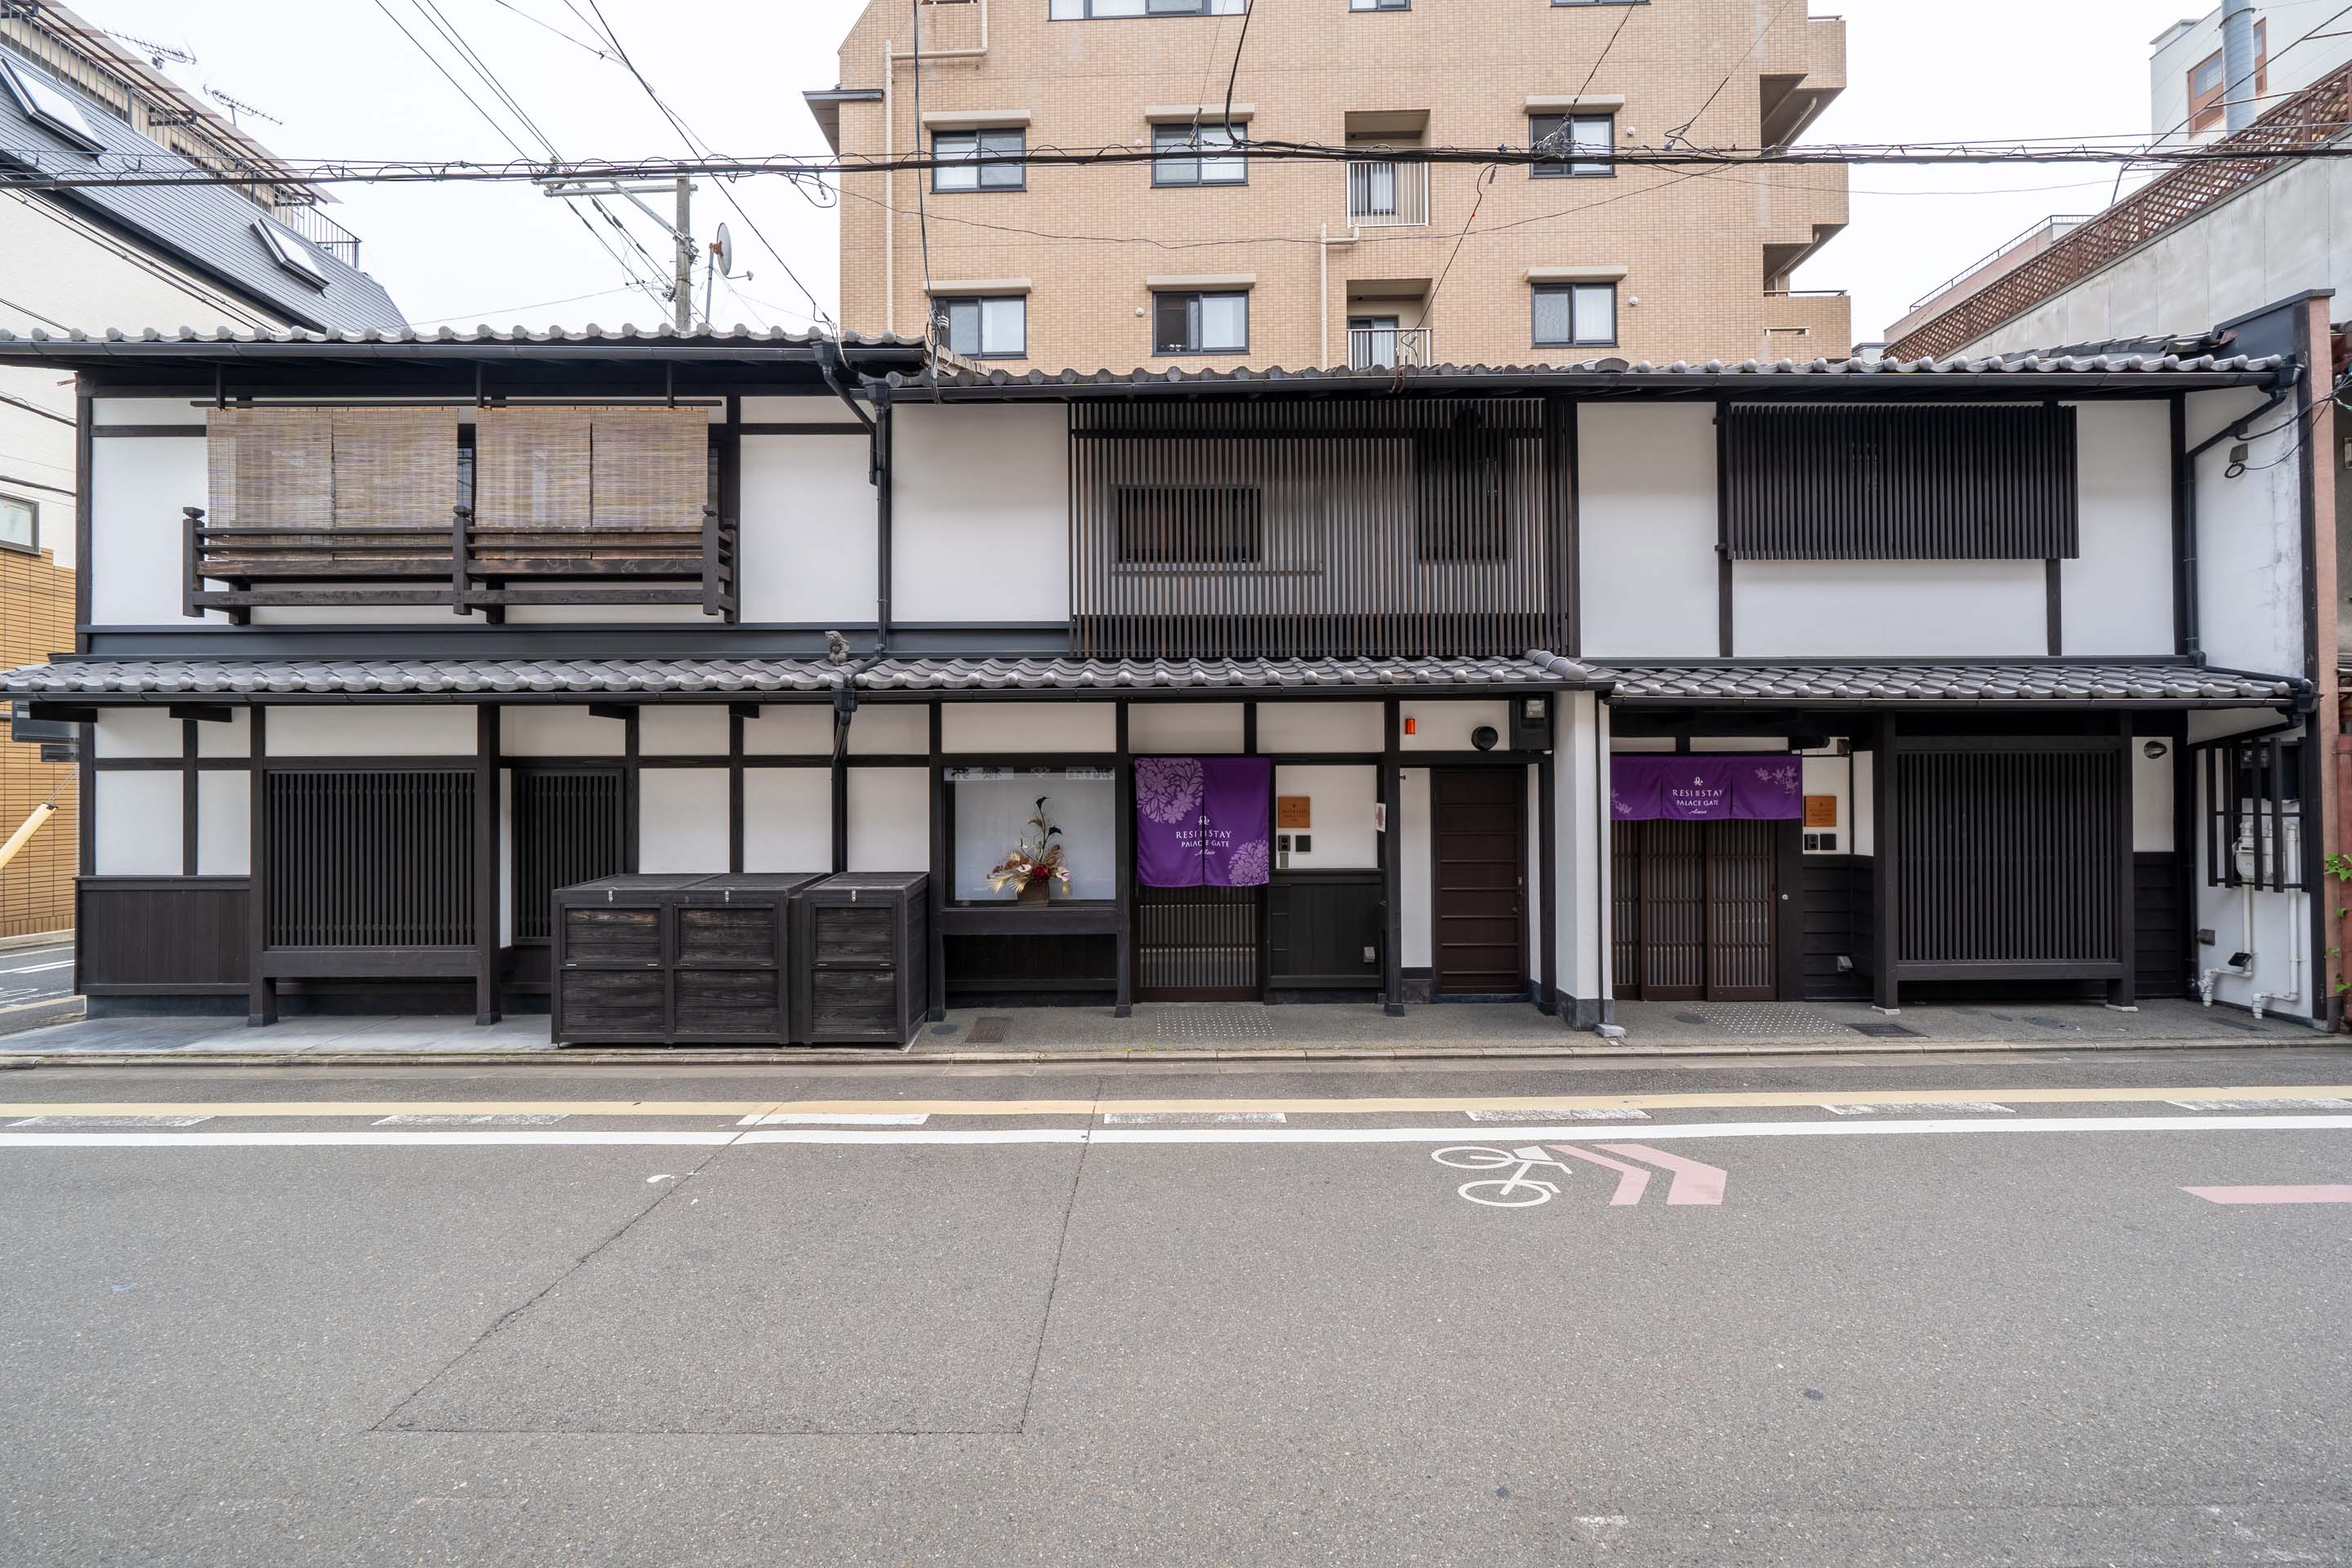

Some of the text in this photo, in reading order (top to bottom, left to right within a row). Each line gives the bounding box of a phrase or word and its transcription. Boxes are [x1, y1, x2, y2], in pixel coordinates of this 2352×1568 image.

[1673, 789, 1724, 797] RESI STAY
[1176, 830, 1232, 839] RESI STAY
[1182, 840, 1229, 848] PALACE GATE
